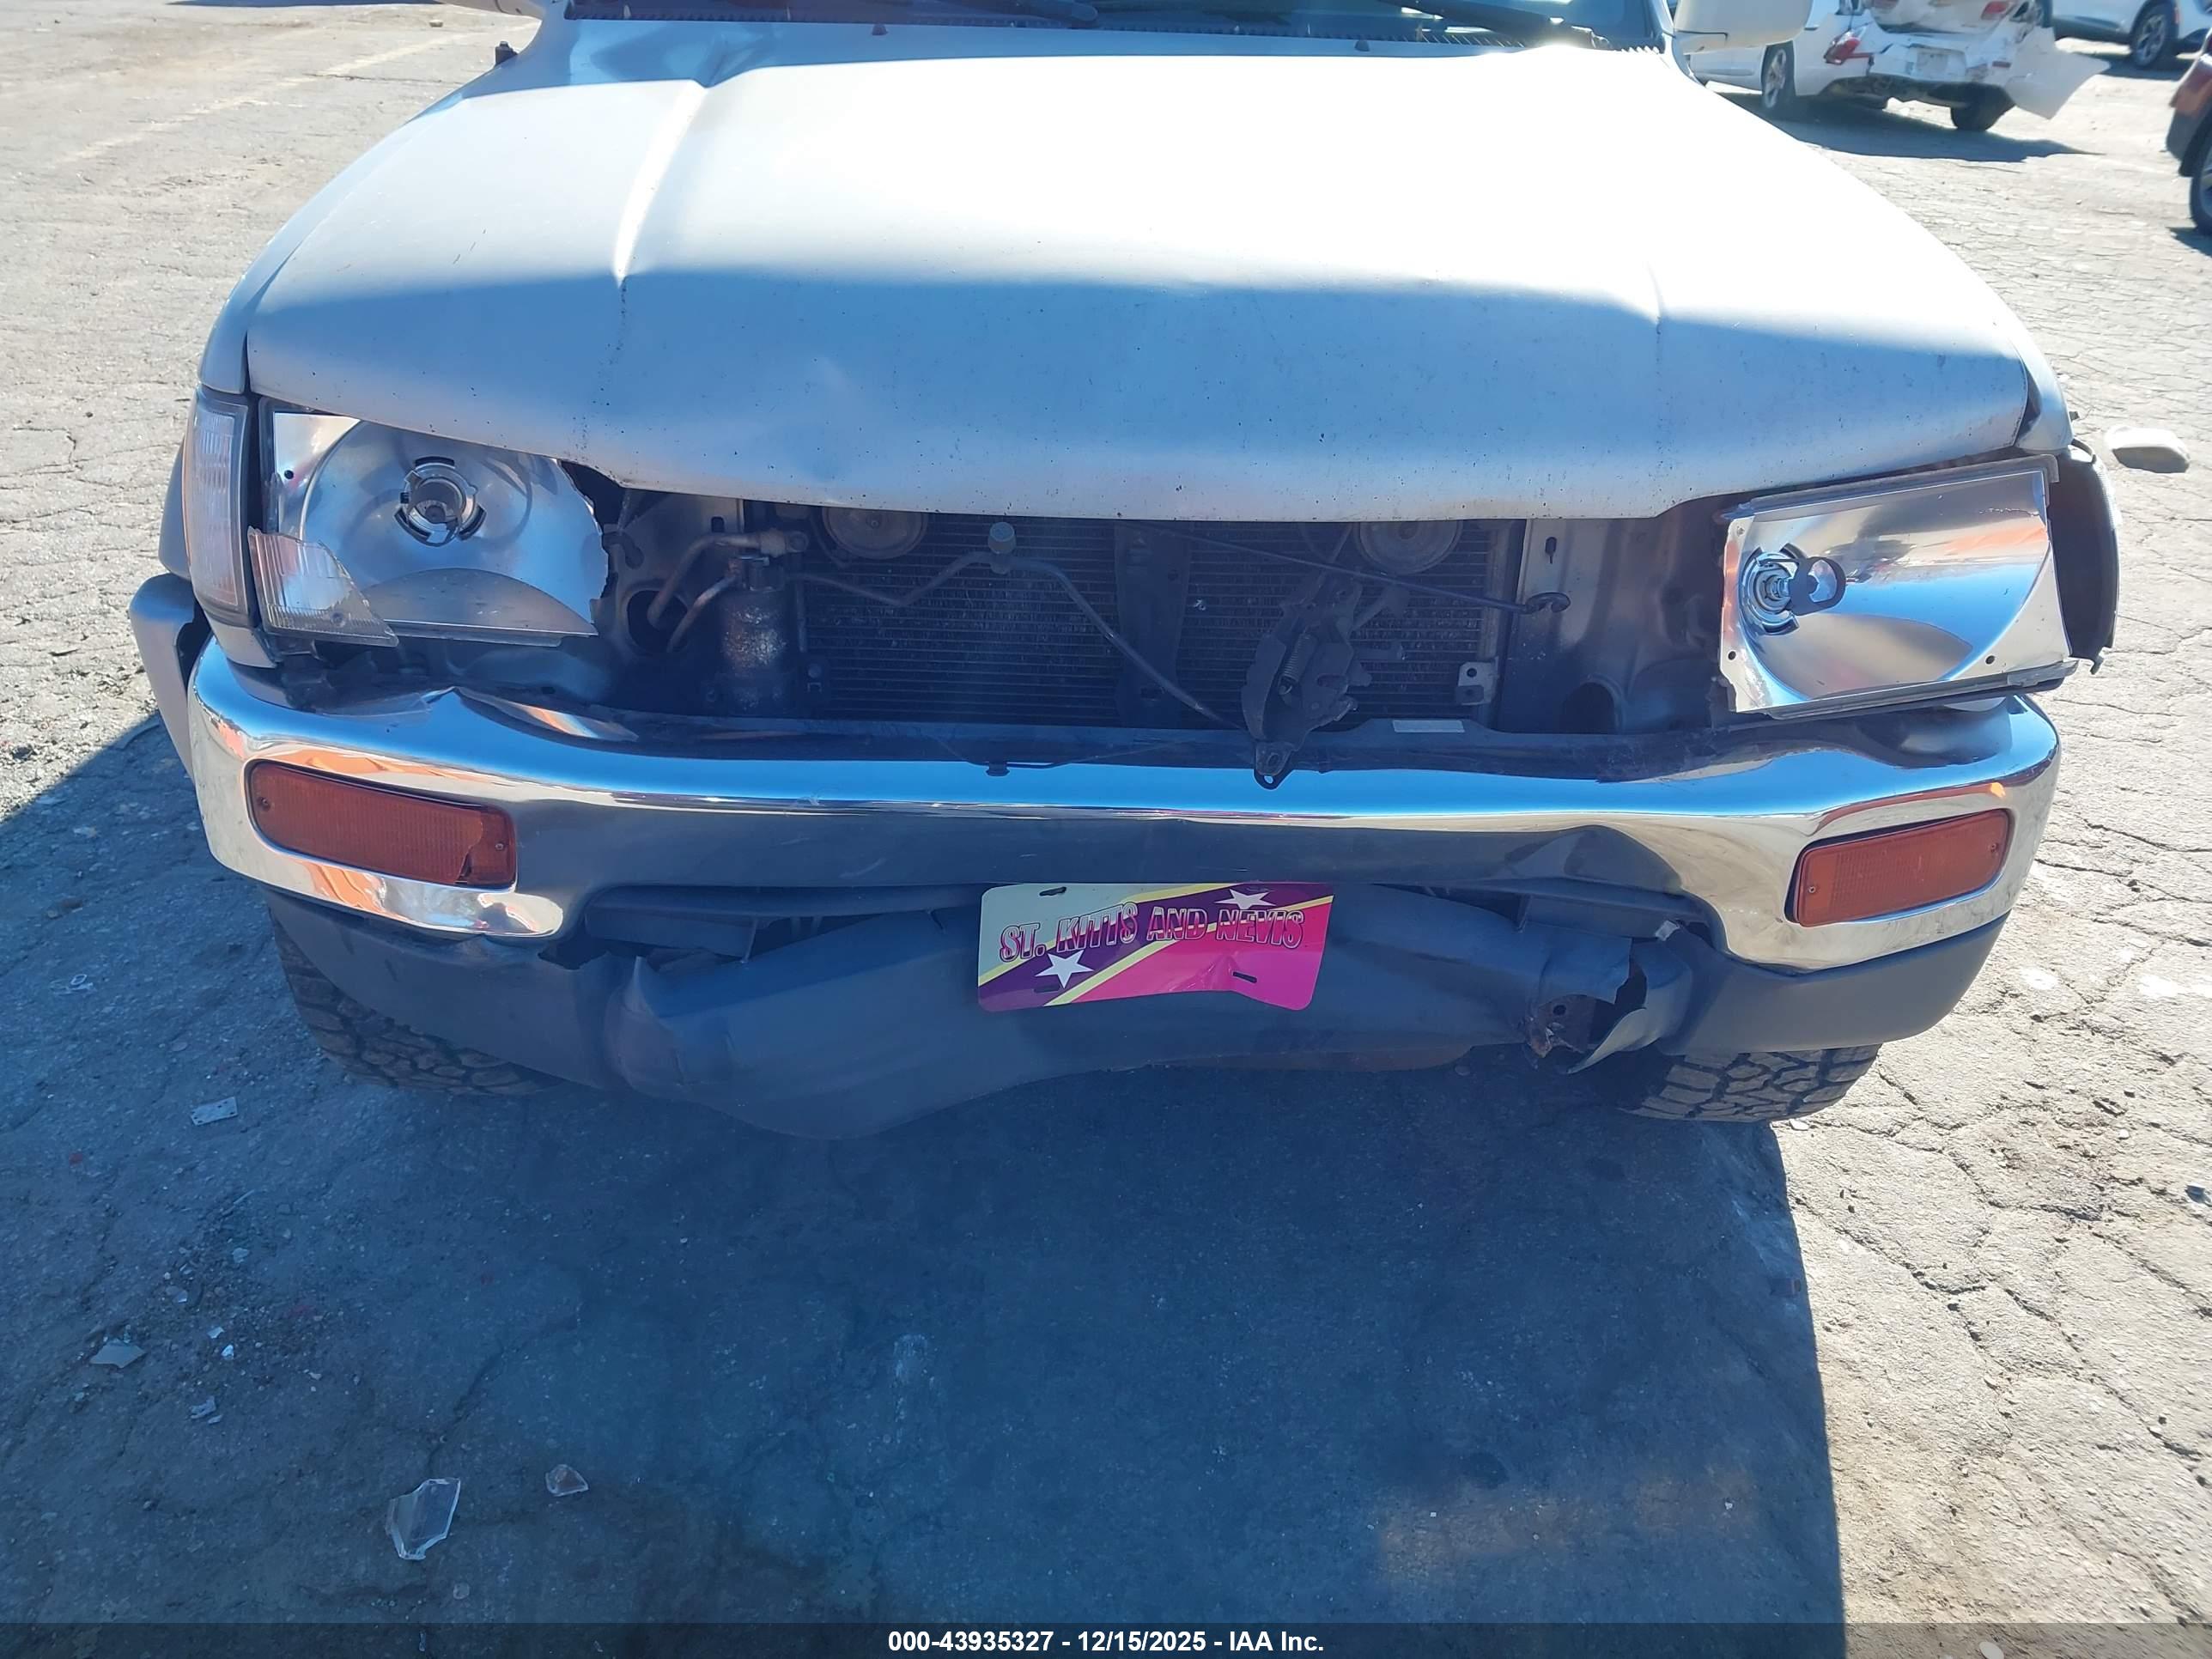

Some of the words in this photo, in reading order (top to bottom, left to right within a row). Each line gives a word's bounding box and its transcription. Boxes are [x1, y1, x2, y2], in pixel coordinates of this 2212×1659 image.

[1000, 922, 1046, 962] ST.
[1056, 902, 1138, 952] KITTS
[1146, 906, 1208, 941] AND
[1215, 908, 1306, 949] NEVIS
